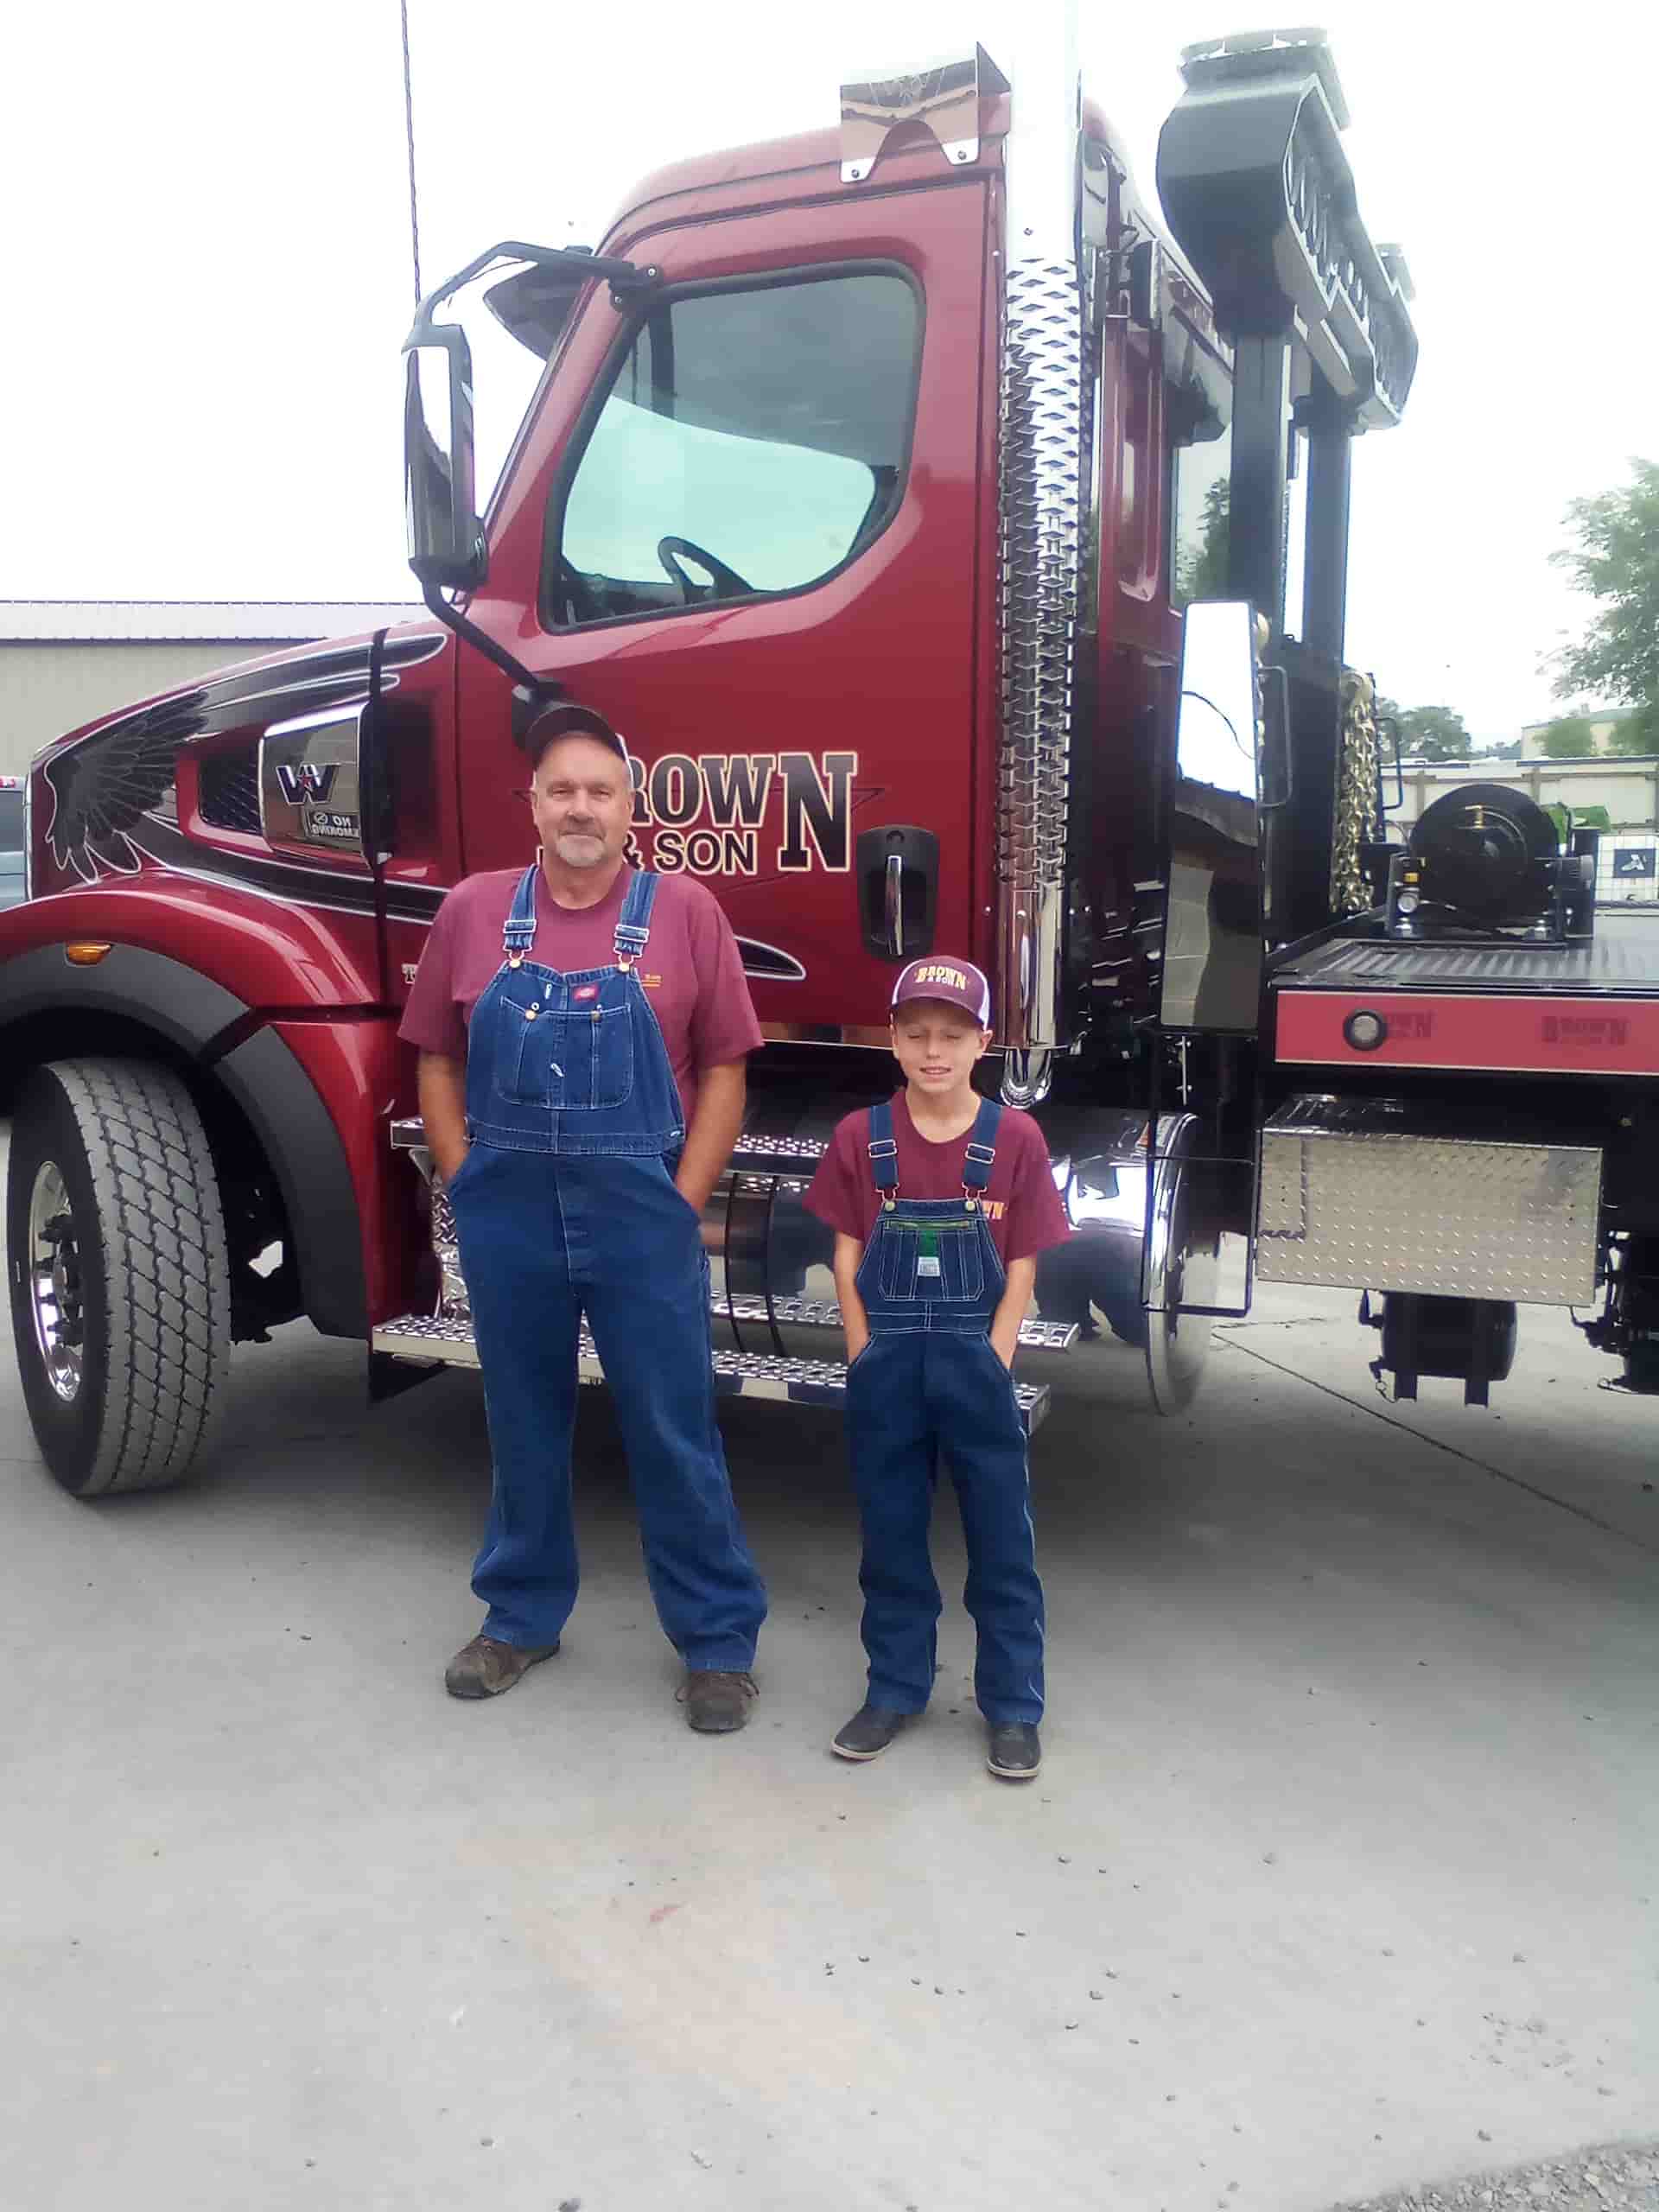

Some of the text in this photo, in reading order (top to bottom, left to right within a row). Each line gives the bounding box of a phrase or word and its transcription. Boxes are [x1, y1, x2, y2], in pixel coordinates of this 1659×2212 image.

[629, 751, 858, 873] ROWN
[653, 830, 758, 876] SON
[915, 965, 967, 990] BROWN
